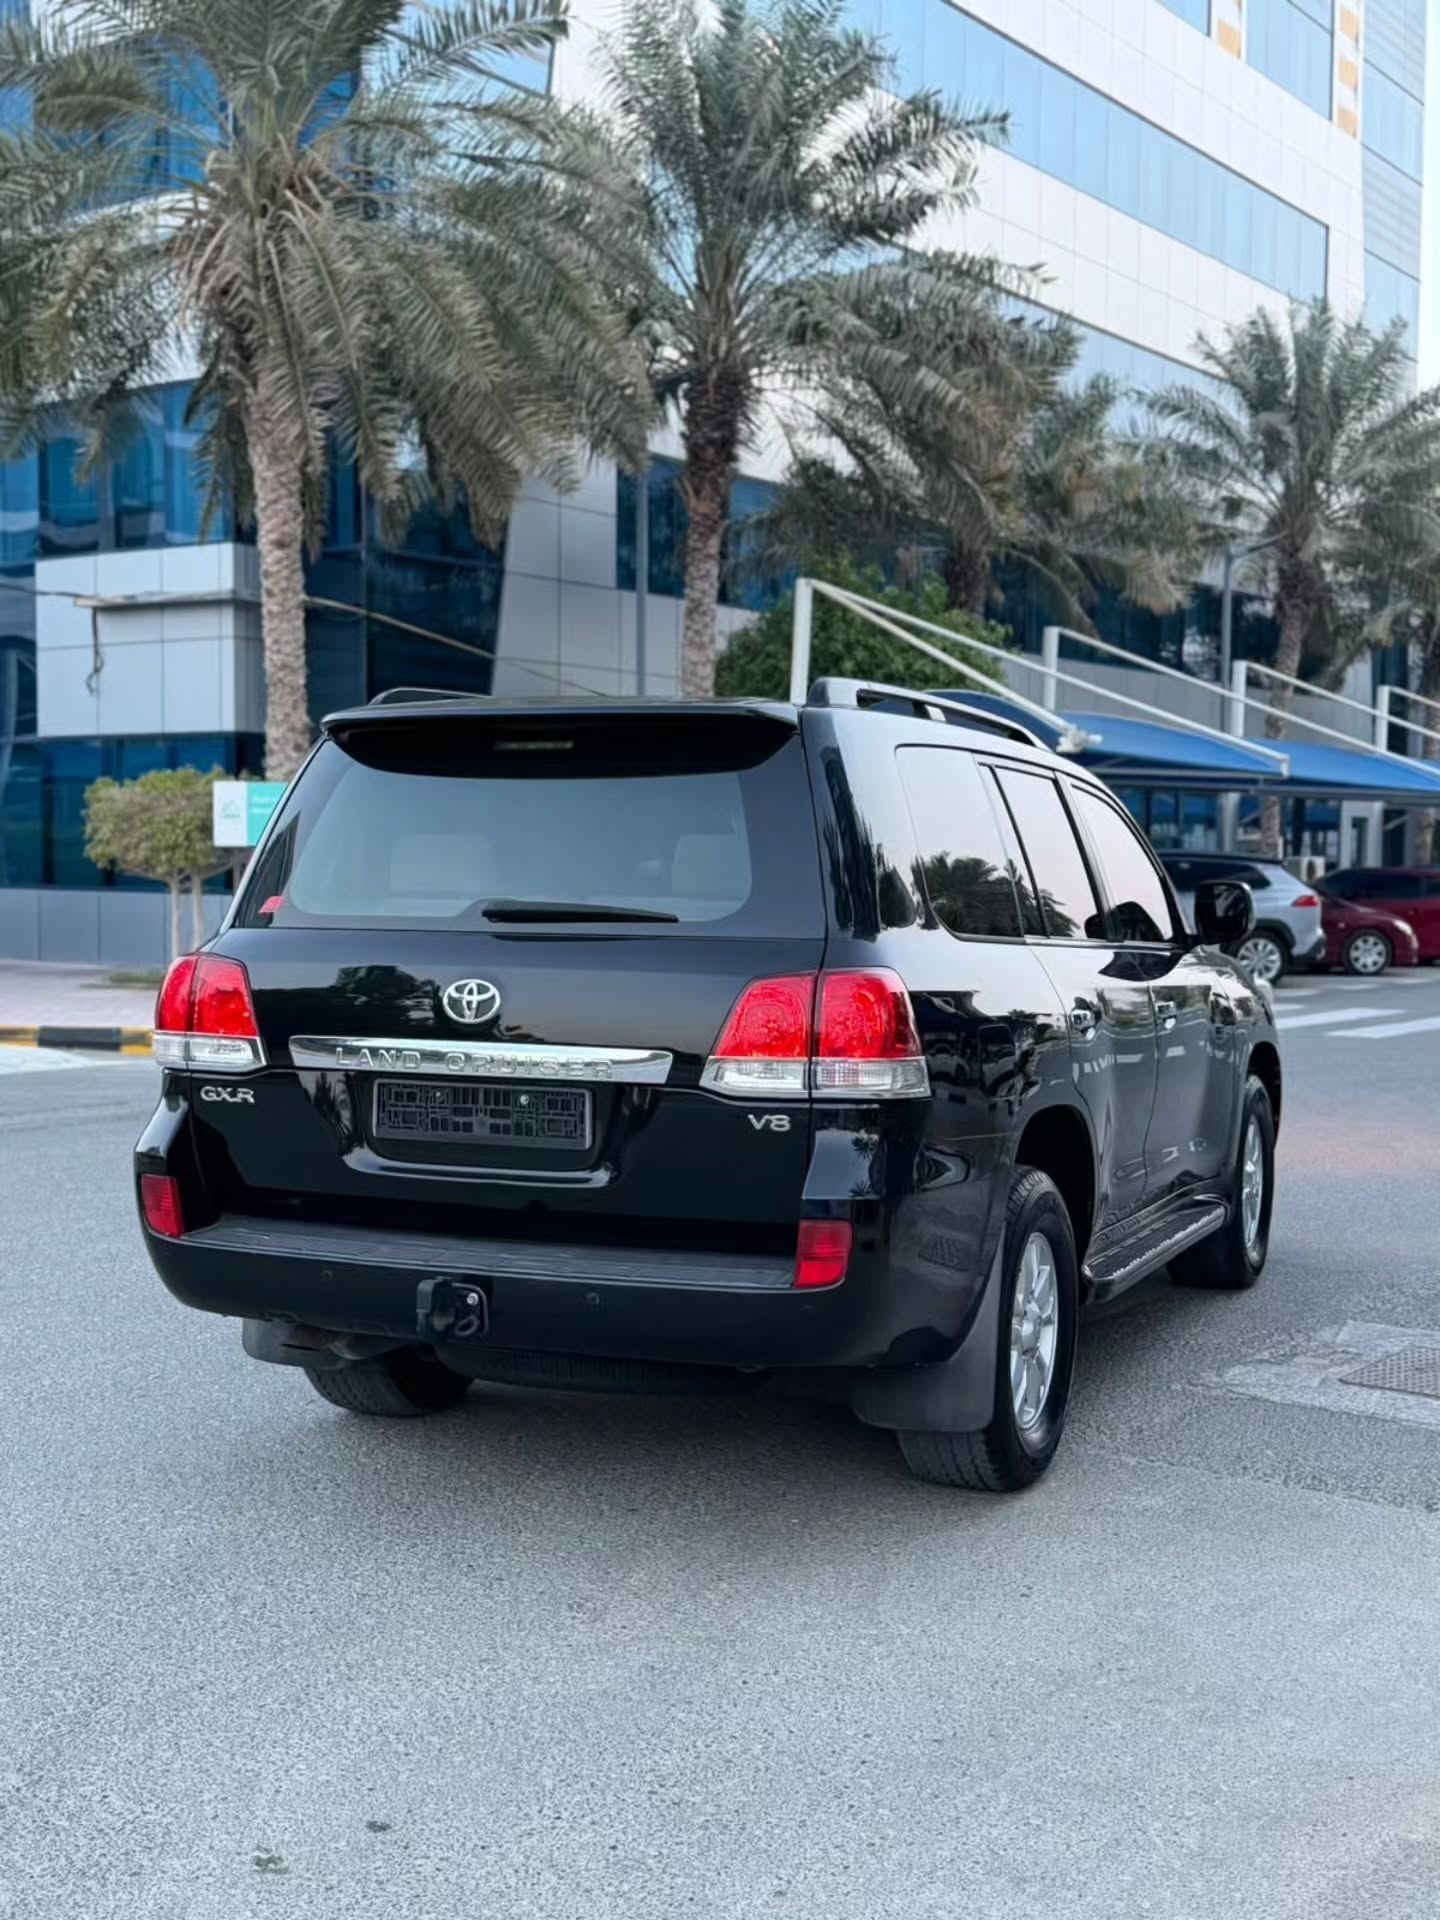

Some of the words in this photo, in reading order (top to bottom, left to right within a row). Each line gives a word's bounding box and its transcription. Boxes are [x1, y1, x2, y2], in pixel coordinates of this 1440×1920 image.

[335, 1047, 421, 1070] LAND
[445, 1051, 614, 1079] CRUISER
[200, 1085, 255, 1104] GXR
[748, 1113, 791, 1132] V8
